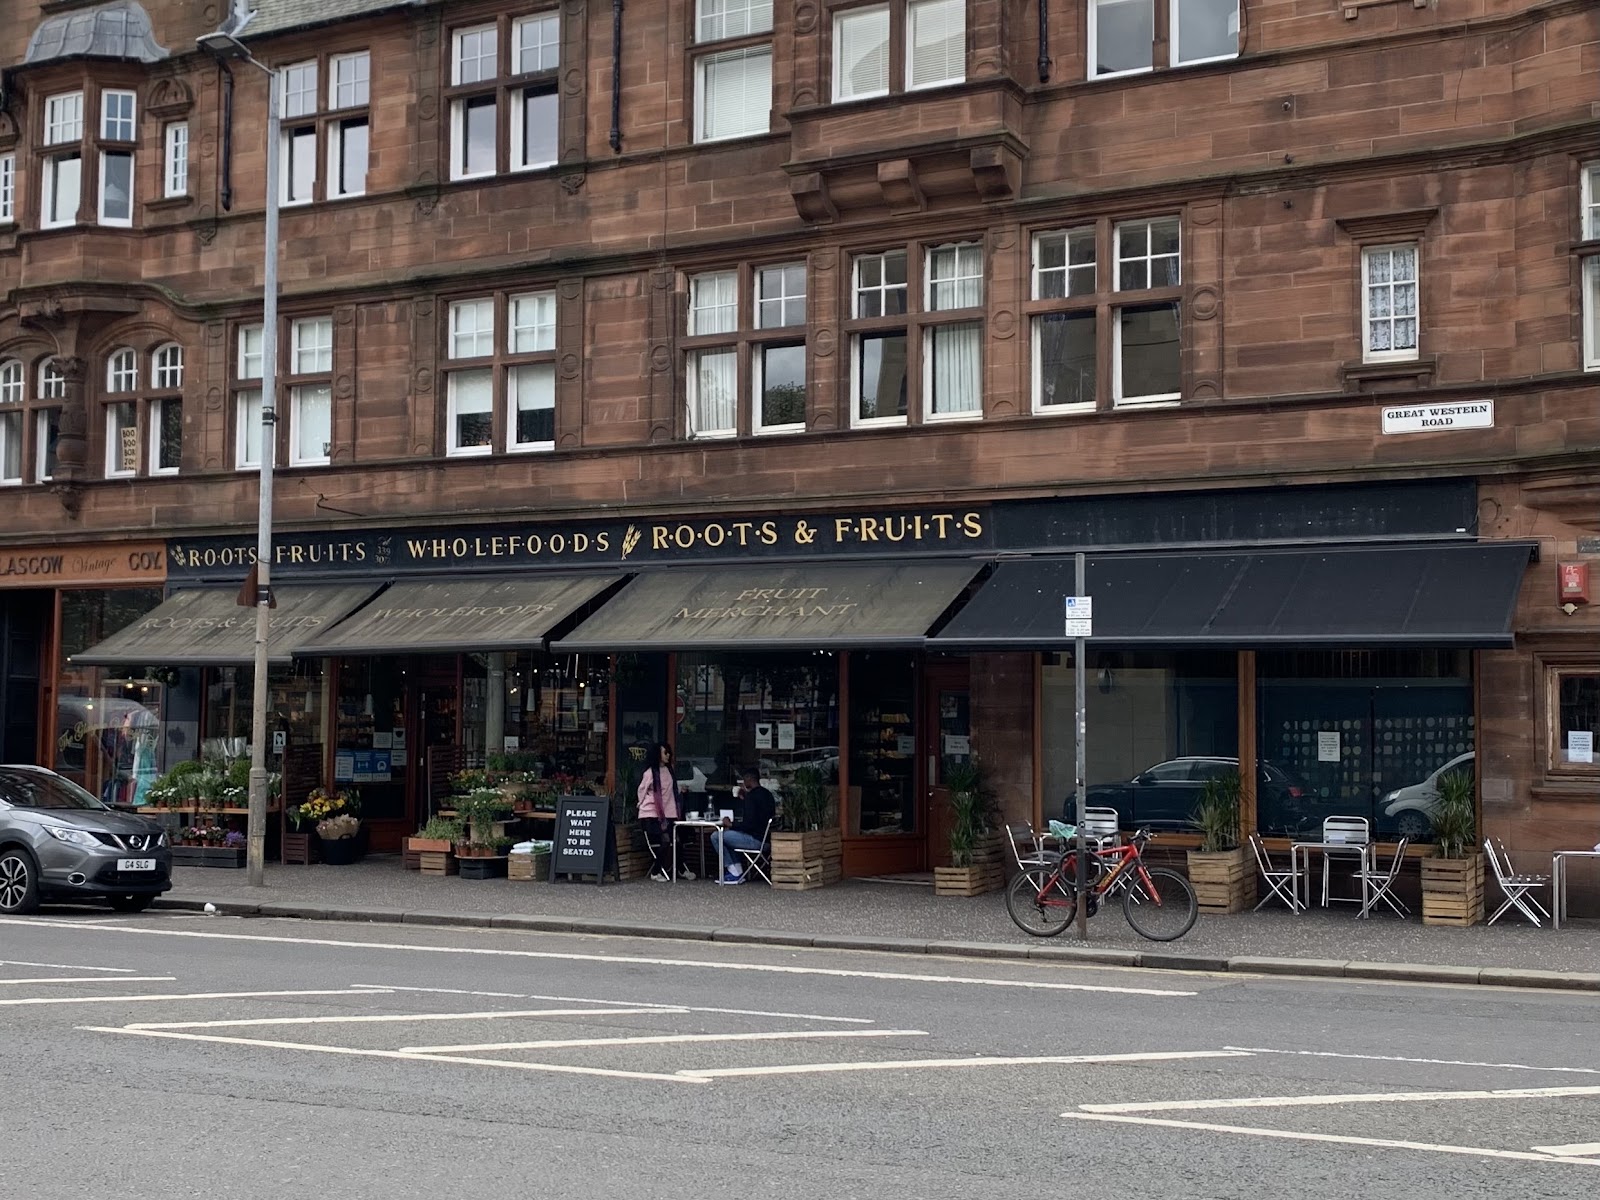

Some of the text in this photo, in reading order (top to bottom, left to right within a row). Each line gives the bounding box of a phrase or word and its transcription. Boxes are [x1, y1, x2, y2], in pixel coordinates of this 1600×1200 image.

[1387, 405, 1488, 419] GREAT WESTERN
[1421, 418, 1453, 427] ROAD
[122, 430, 134, 438] BOO
[124, 440, 136, 448] BOO
[794, 519, 818, 544] &
[71, 554, 118, 574] Vintage
[736, 587, 828, 600] FRUIT
[373, 602, 558, 619] WHOLEFOODS
[672, 603, 858, 619] MERCHANT
[138, 615, 328, 629] ROOTS & FUITS
[569, 829, 591, 837] HERE
[579, 838, 591, 846] BE
[562, 848, 594, 856] SEATED
[124, 860, 149, 869] G4 SLG
